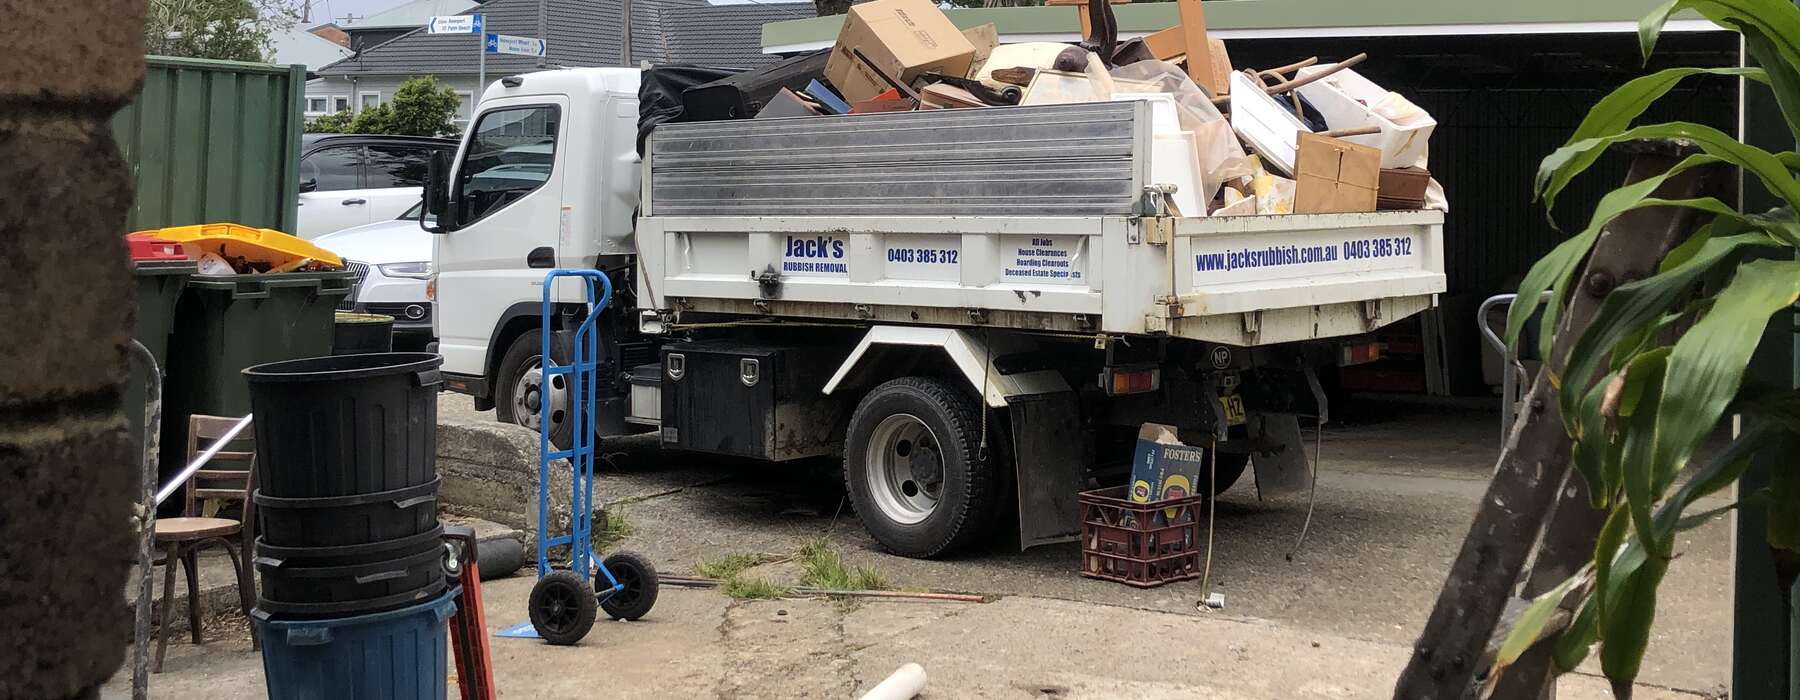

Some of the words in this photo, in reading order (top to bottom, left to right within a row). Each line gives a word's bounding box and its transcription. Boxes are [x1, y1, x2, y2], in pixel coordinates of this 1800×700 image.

[785, 235, 844, 259] Jack's
[1032, 238, 1040, 246] All
[1040, 238, 1053, 247] Jobs
[887, 248, 914, 264] 0403
[916, 249, 937, 264] 385
[939, 249, 958, 264] 312
[1018, 248, 1035, 257] House
[1036, 248, 1067, 258] Clearances
[1195, 244, 1338, 272] www.jacksrubbish.com.au
[1343, 240, 1371, 261] 0403
[1372, 238, 1393, 258] 385
[1394, 236, 1412, 256] 312
[783, 261, 814, 273] RUBBISH
[815, 262, 848, 274] REMOVAL
[1016, 258, 1041, 268] Hoarding
[1005, 268, 1032, 277] Deceased
[1032, 269, 1049, 278] Estate
